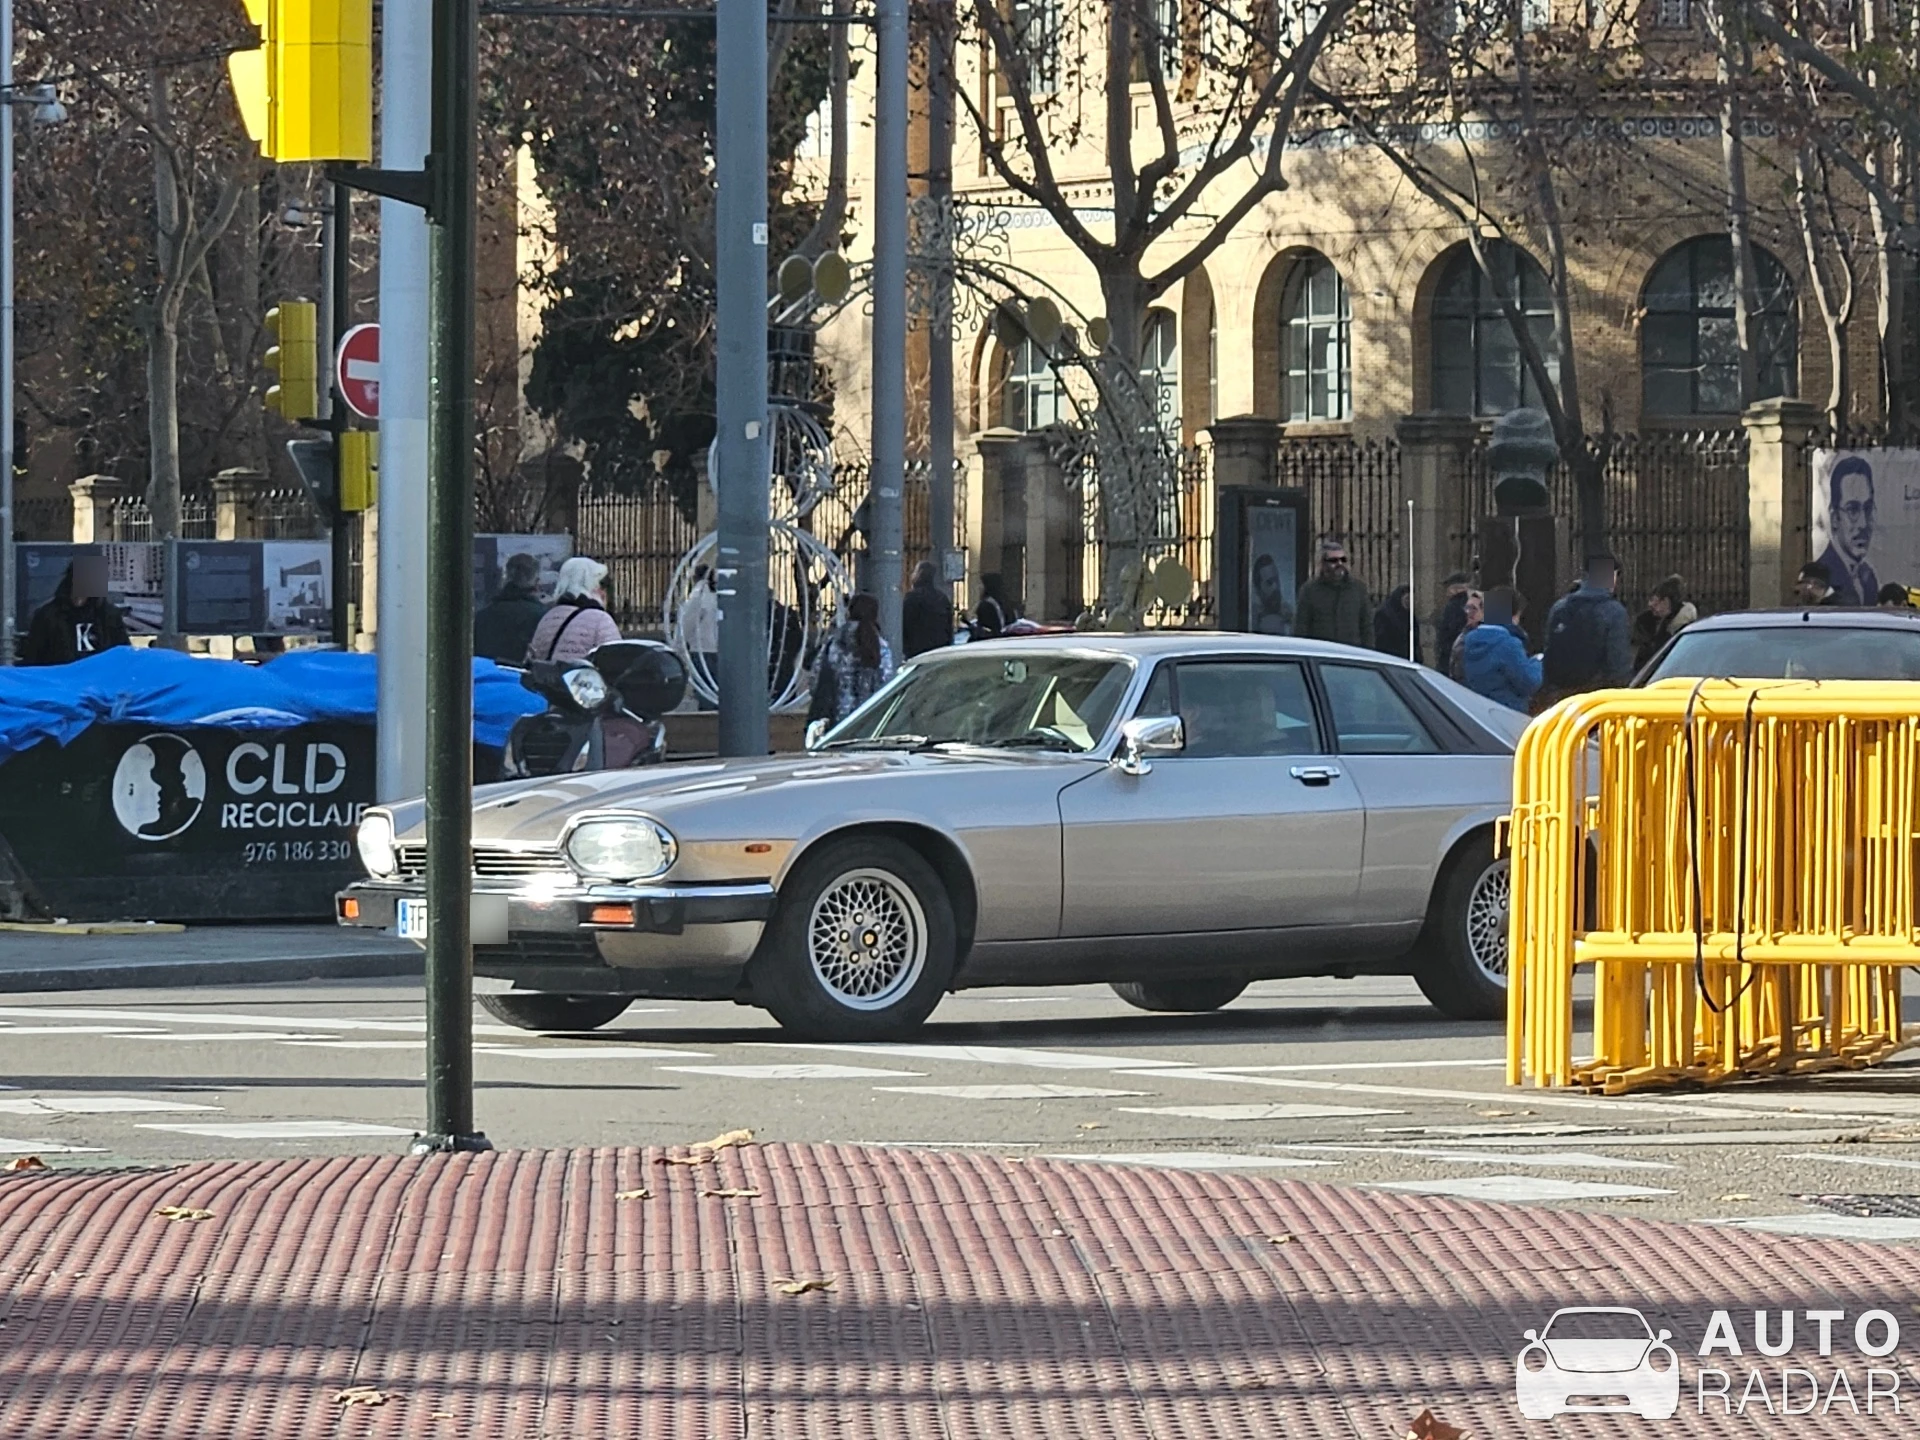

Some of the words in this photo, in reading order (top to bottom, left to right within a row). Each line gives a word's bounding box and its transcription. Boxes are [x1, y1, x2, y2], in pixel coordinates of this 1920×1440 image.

[76, 622, 96, 652] K
[226, 742, 347, 795] CLD
[221, 801, 370, 829] RECICLAJE
[244, 843, 277, 863] 976
[283, 841, 314, 861] 186
[317, 840, 351, 861] 330
